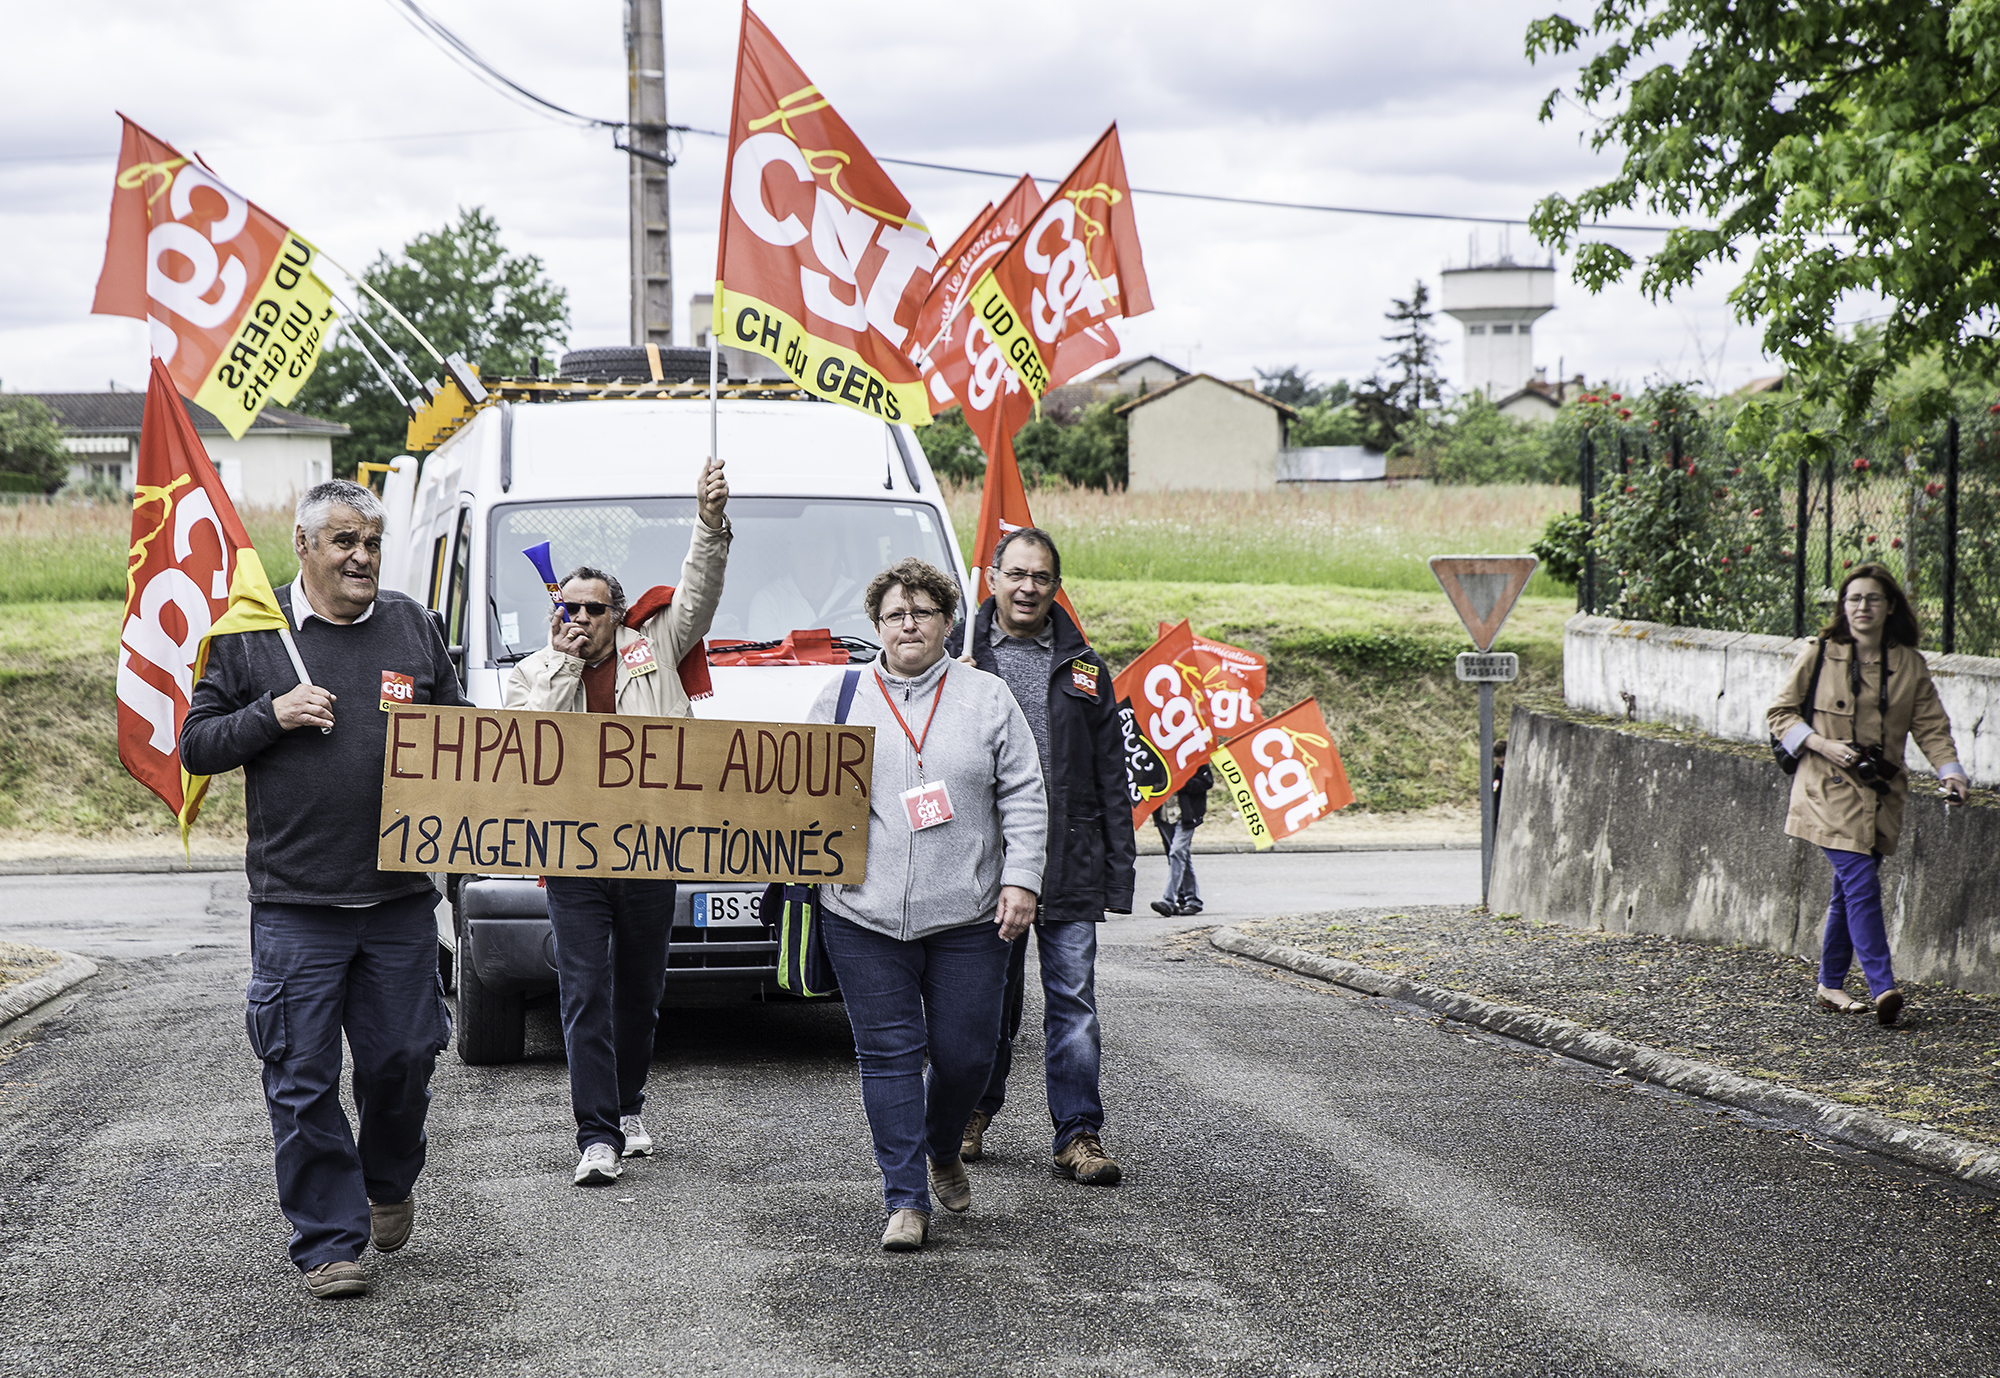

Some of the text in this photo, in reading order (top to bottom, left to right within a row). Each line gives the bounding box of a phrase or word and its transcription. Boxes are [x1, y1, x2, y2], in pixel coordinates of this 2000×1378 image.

[730, 131, 940, 351] cgt
[945, 272, 962, 294] le
[959, 228, 992, 274] droit
[1024, 198, 1120, 343] cgt
[735, 307, 782, 353] CH
[785, 335, 808, 380] du
[816, 356, 902, 421] GERS
[983, 294, 1047, 398] UD GER
[624, 645, 651, 664] cgt
[631, 663, 655, 676] GERS
[1192, 640, 1257, 666] unication
[1466, 668, 1510, 676] PASSAGE
[1501, 657, 1511, 666] LE
[383, 681, 412, 700] cgt
[1144, 663, 1213, 770] cgt
[1205, 686, 1254, 729] gt
[390, 712, 868, 798] EHPAD BEL ADOUR
[1251, 728, 1328, 832] cgt
[1281, 725, 1329, 811] la
[917, 799, 942, 818] cgt
[1221, 760, 1265, 836] UD GERS
[381, 815, 442, 865] 18
[448, 816, 600, 871] AGENTS
[711, 896, 761, 920] BS-9
